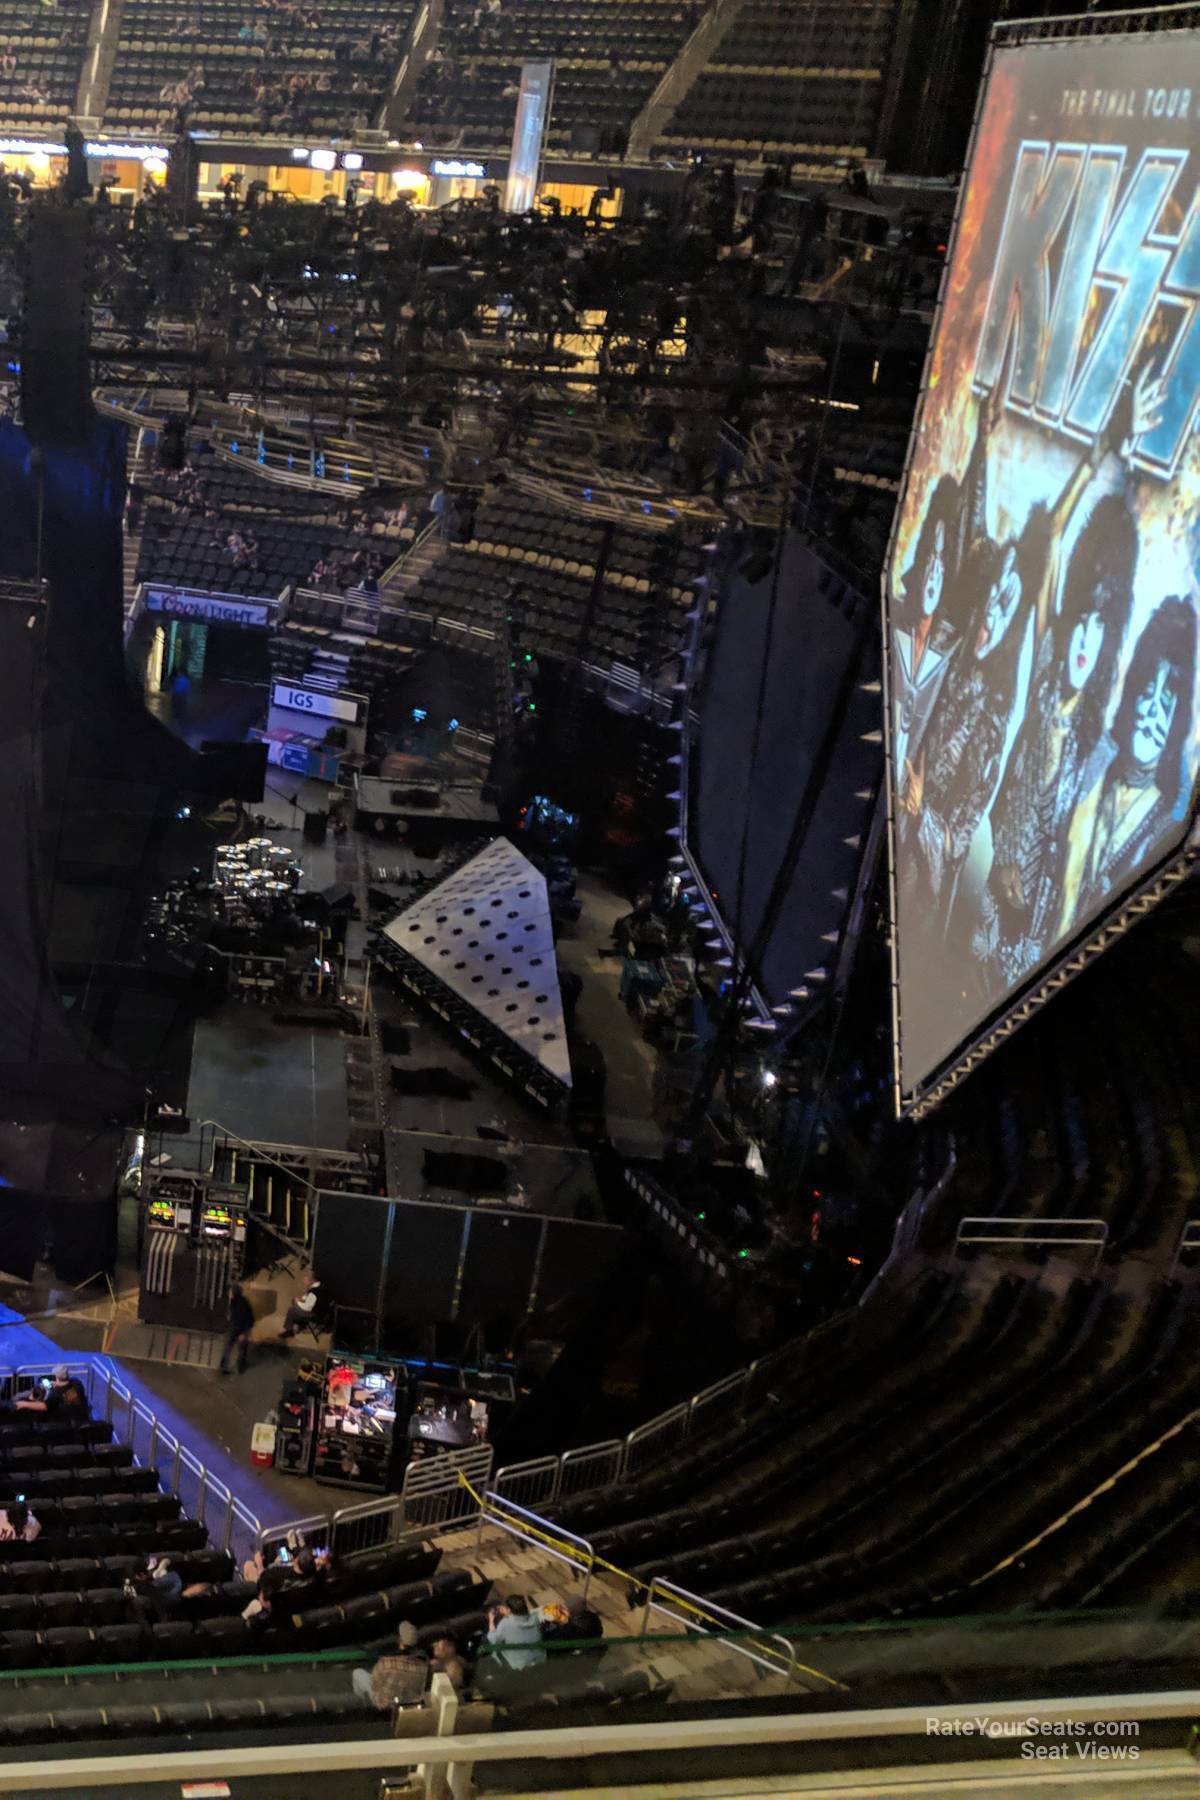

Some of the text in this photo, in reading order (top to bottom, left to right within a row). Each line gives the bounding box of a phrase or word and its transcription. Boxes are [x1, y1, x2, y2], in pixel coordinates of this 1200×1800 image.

[1091, 88, 1136, 118] FINAL
[1143, 86, 1192, 119] TOUR
[289, 691, 313, 709] IGS
